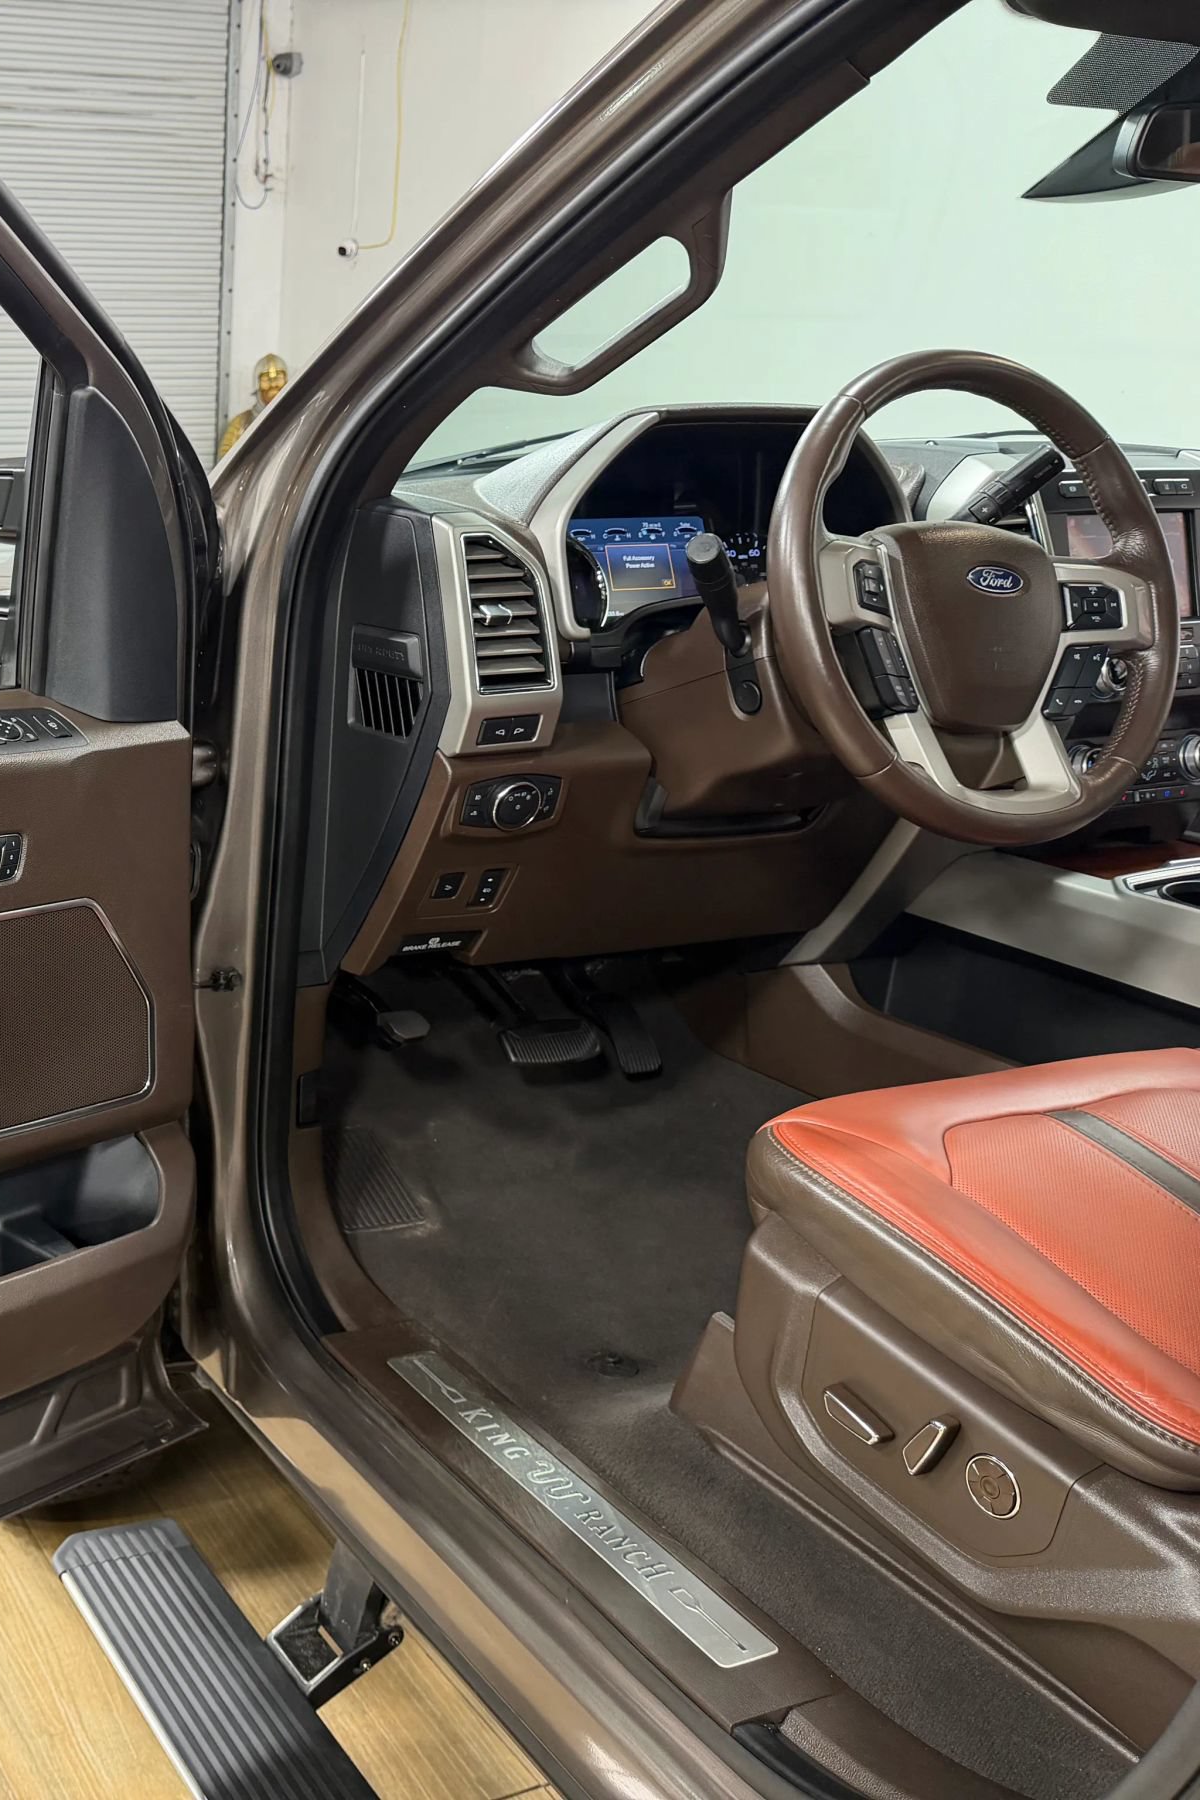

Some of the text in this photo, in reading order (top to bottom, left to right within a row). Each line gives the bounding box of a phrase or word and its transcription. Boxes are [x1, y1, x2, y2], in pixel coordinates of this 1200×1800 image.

[749, 549, 760, 557] 60
[979, 569, 1013, 589] Ford
[402, 940, 462, 952] BRAKE RELEASE
[459, 1406, 532, 1461] KING
[574, 1509, 675, 1582] RANCH
